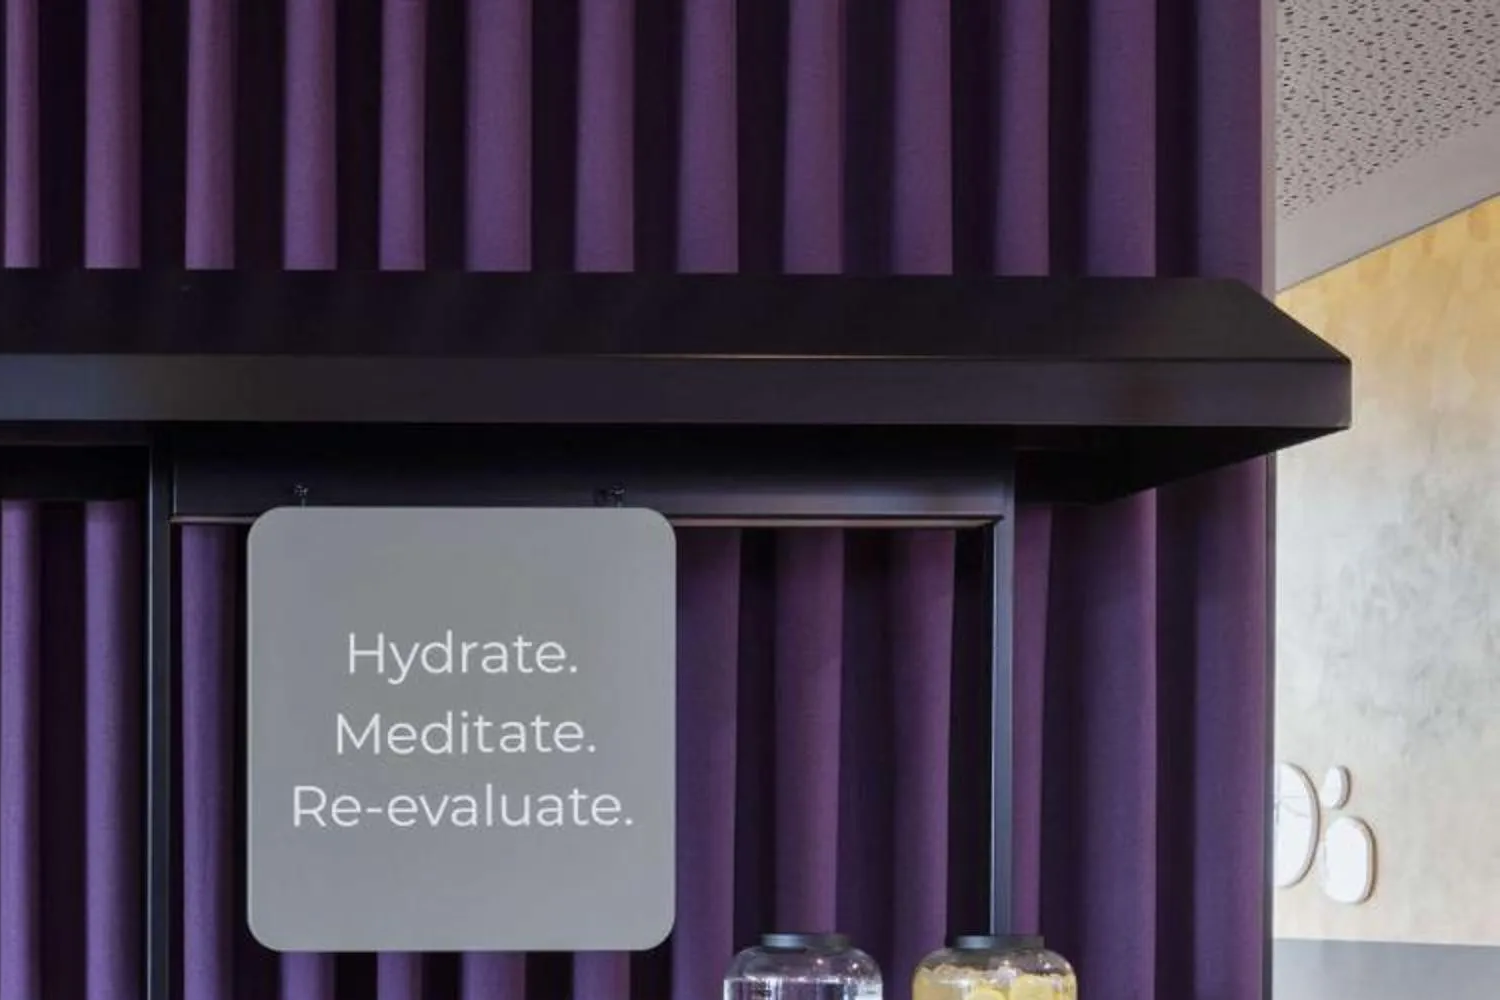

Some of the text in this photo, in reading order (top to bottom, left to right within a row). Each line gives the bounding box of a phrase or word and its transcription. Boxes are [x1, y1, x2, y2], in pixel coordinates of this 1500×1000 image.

[347, 630, 578, 685] Hydrate.
[336, 710, 596, 755] Meditate.
[292, 783, 634, 828] Re-evaluate.
